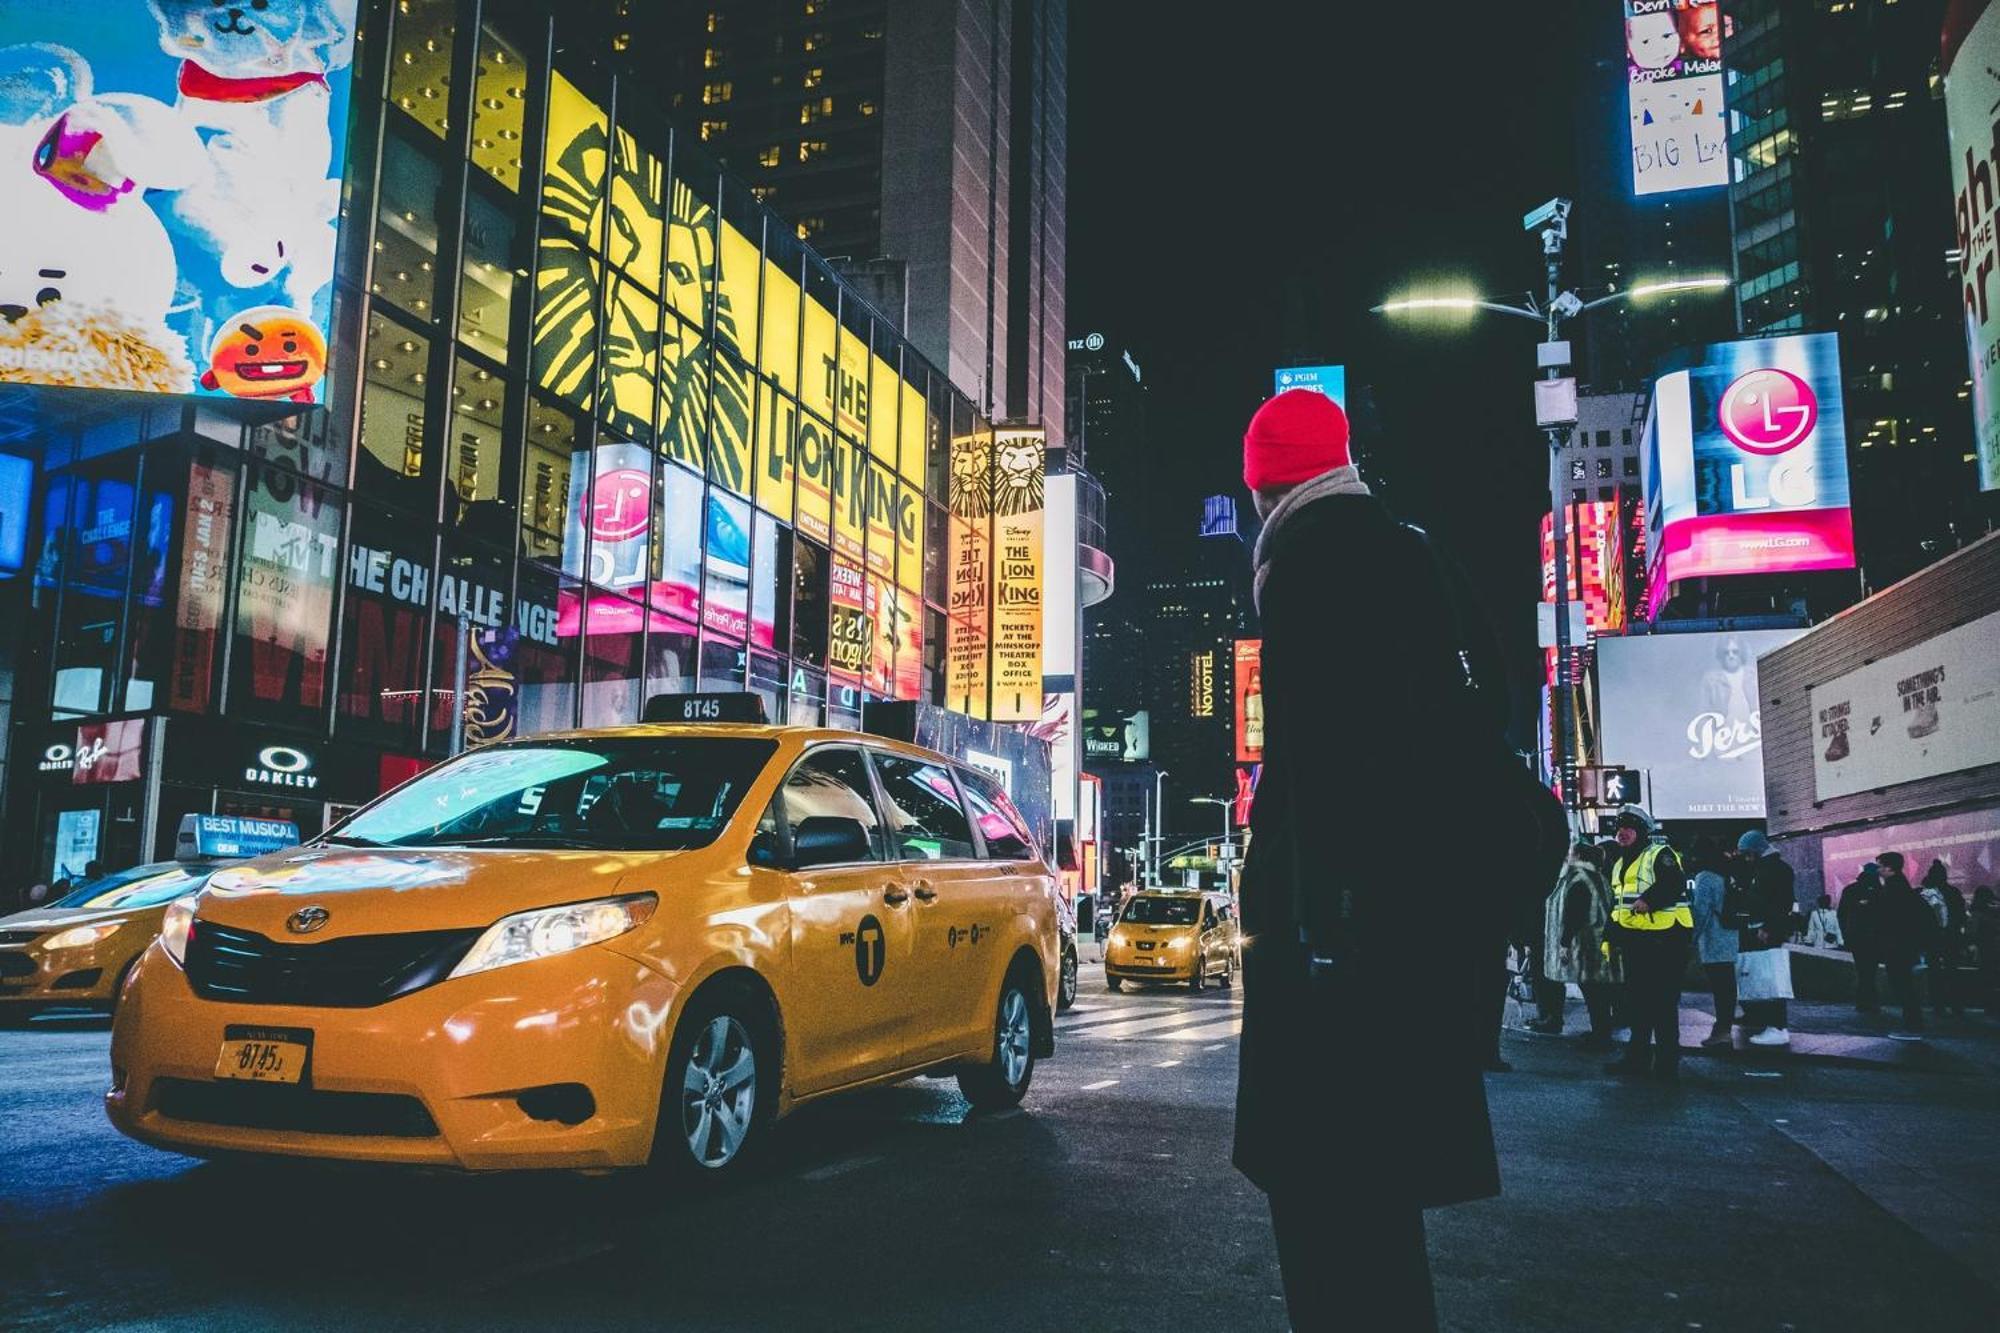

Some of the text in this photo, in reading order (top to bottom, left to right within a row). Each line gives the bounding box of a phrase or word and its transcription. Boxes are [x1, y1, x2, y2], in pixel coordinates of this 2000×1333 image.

[1635, 138, 1680, 174] BIG
[1971, 221, 1992, 257] THE
[822, 352, 866, 425] THE
[768, 371, 916, 544] LION KING
[1731, 458, 1817, 511] LG
[196, 513, 213, 548] JAN
[1005, 546, 1029, 558] THE
[1001, 560, 1035, 580] LION
[391, 557, 560, 646] CHALLENGE
[998, 582, 1039, 605] KING
[1001, 624, 1035, 632] TICKETS
[1016, 633, 1033, 641] THE
[994, 642, 1041, 650] MINSKOFF
[999, 651, 1036, 659] THEATRE
[1201, 650, 1214, 717] NOVOTEL
[683, 700, 720, 718] 8T45
[1903, 695, 1912, 713] IN
[1911, 690, 1926, 709] THE
[1086, 739, 1120, 751] WICKED
[38, 760, 74, 771] OAKLEY
[245, 768, 318, 789] OAKLEY
[1688, 804, 1714, 812] MEET
[202, 817, 295, 839] BEST MUSICAL
